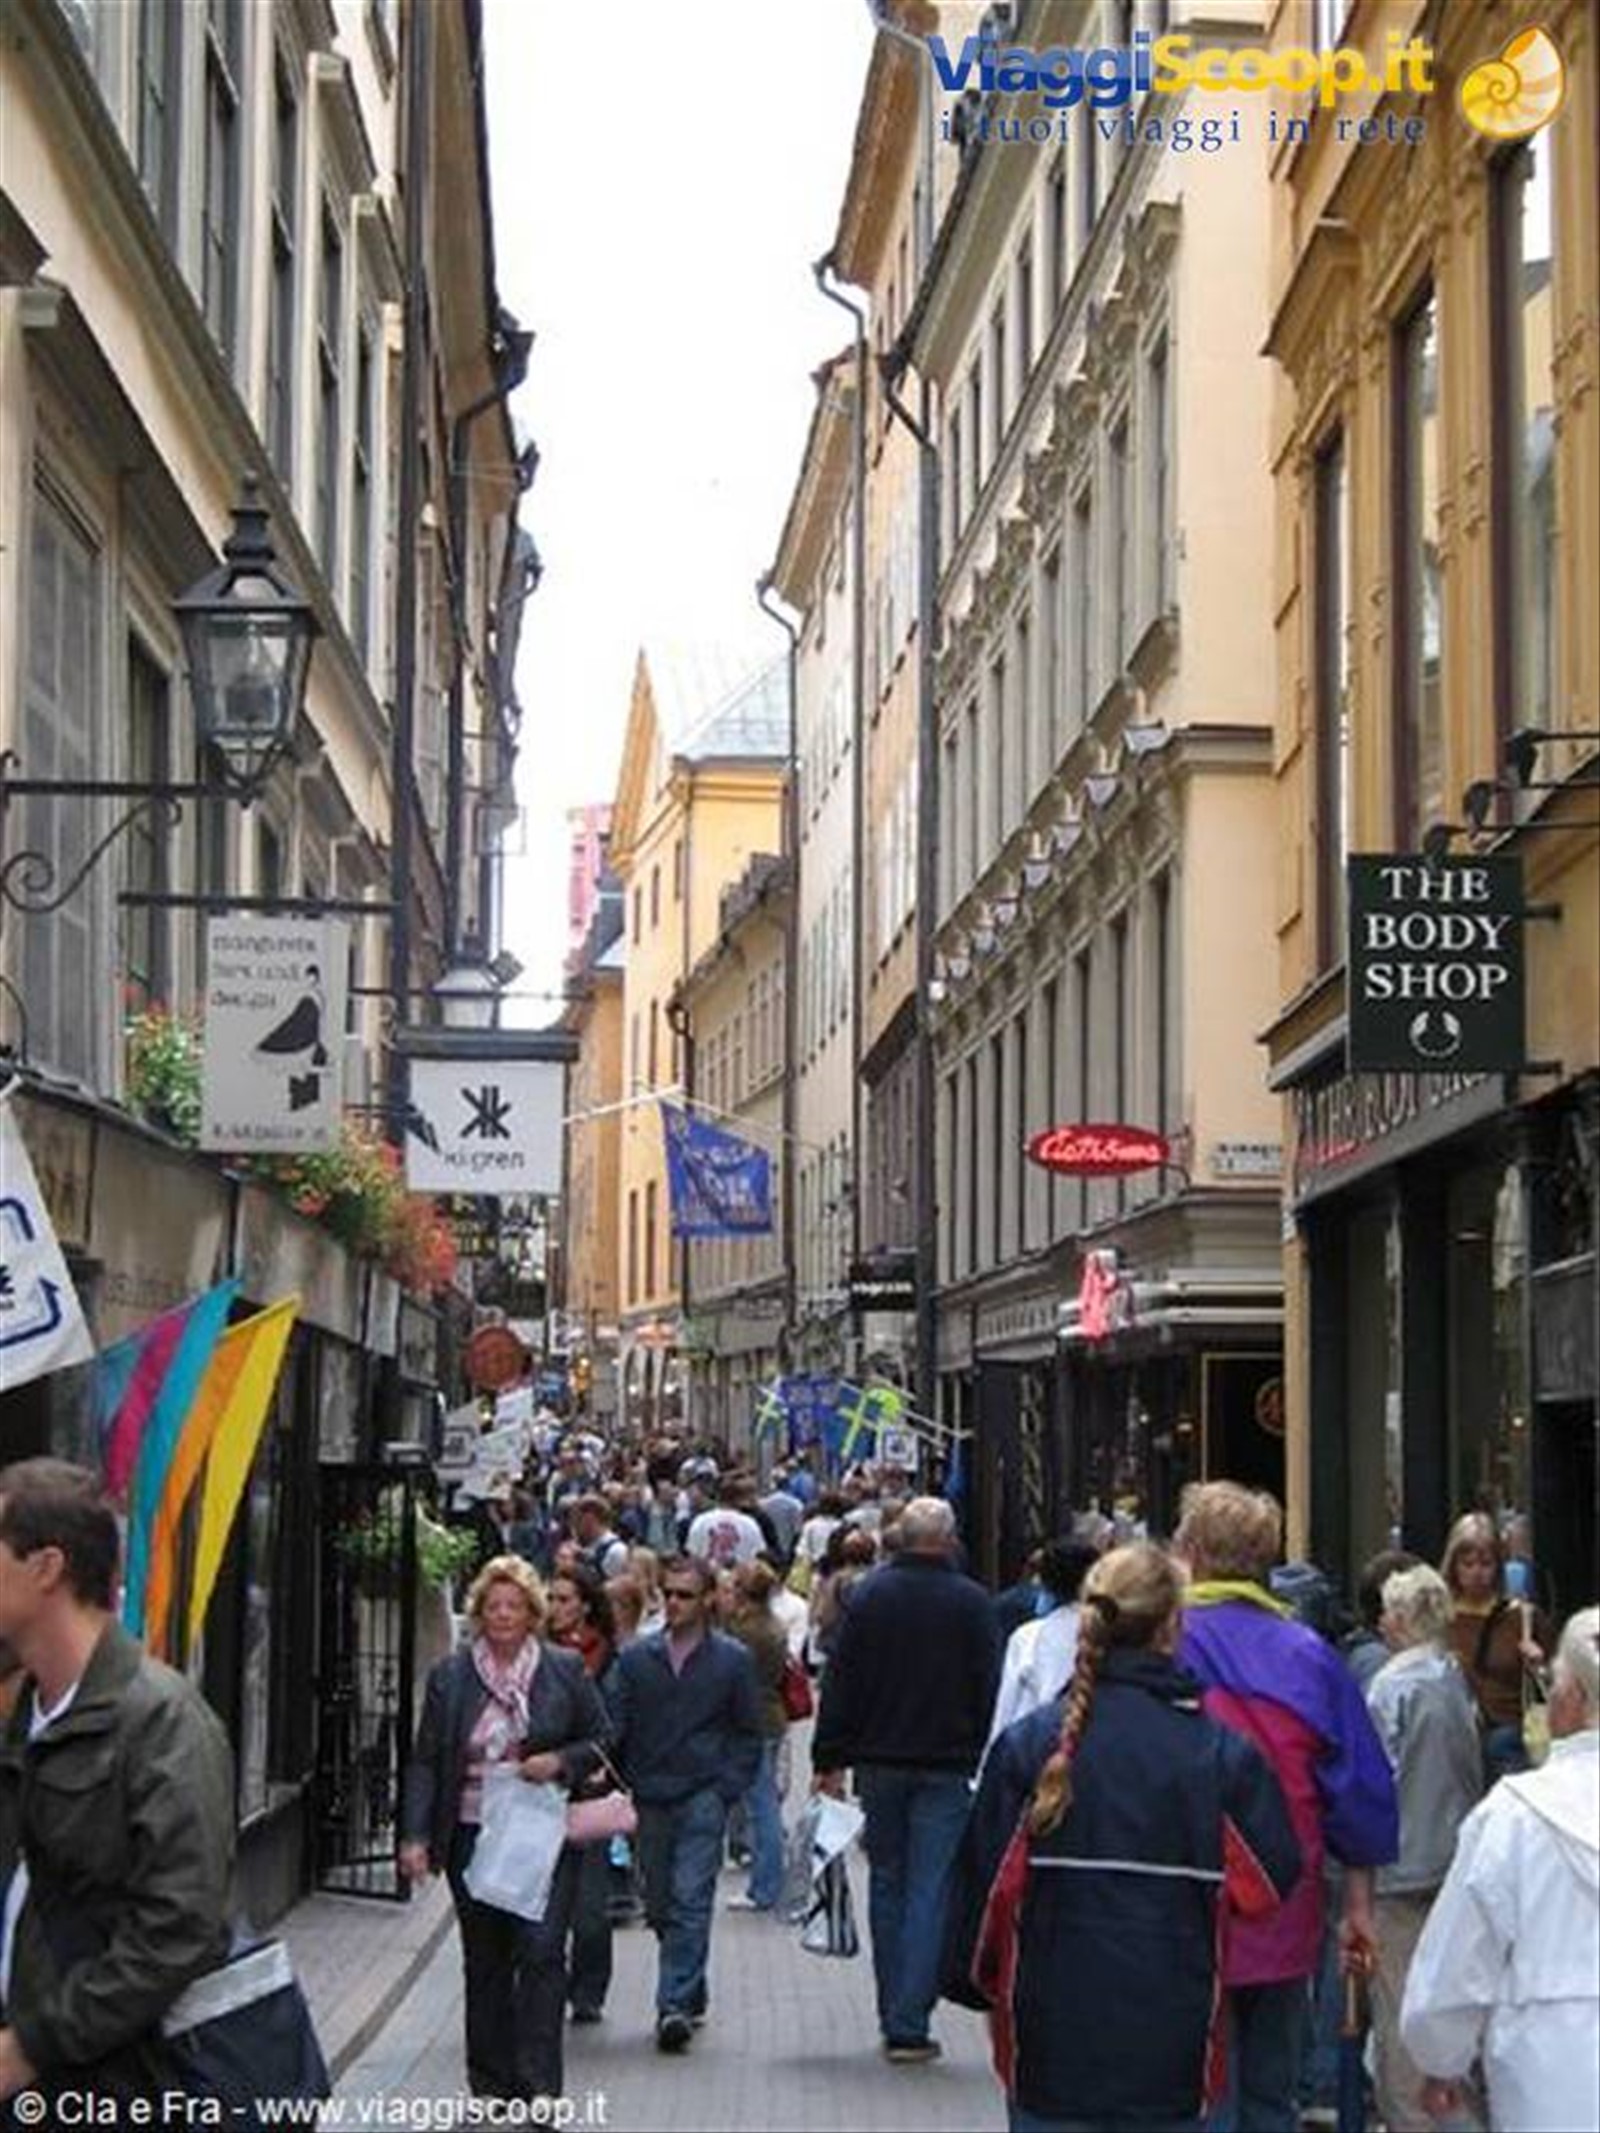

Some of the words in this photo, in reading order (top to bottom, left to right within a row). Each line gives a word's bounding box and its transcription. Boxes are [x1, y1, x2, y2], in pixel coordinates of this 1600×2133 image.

[1379, 866, 1491, 901] THE
[1363, 911, 1513, 951] BODY
[1364, 963, 1509, 1001] SHOP
